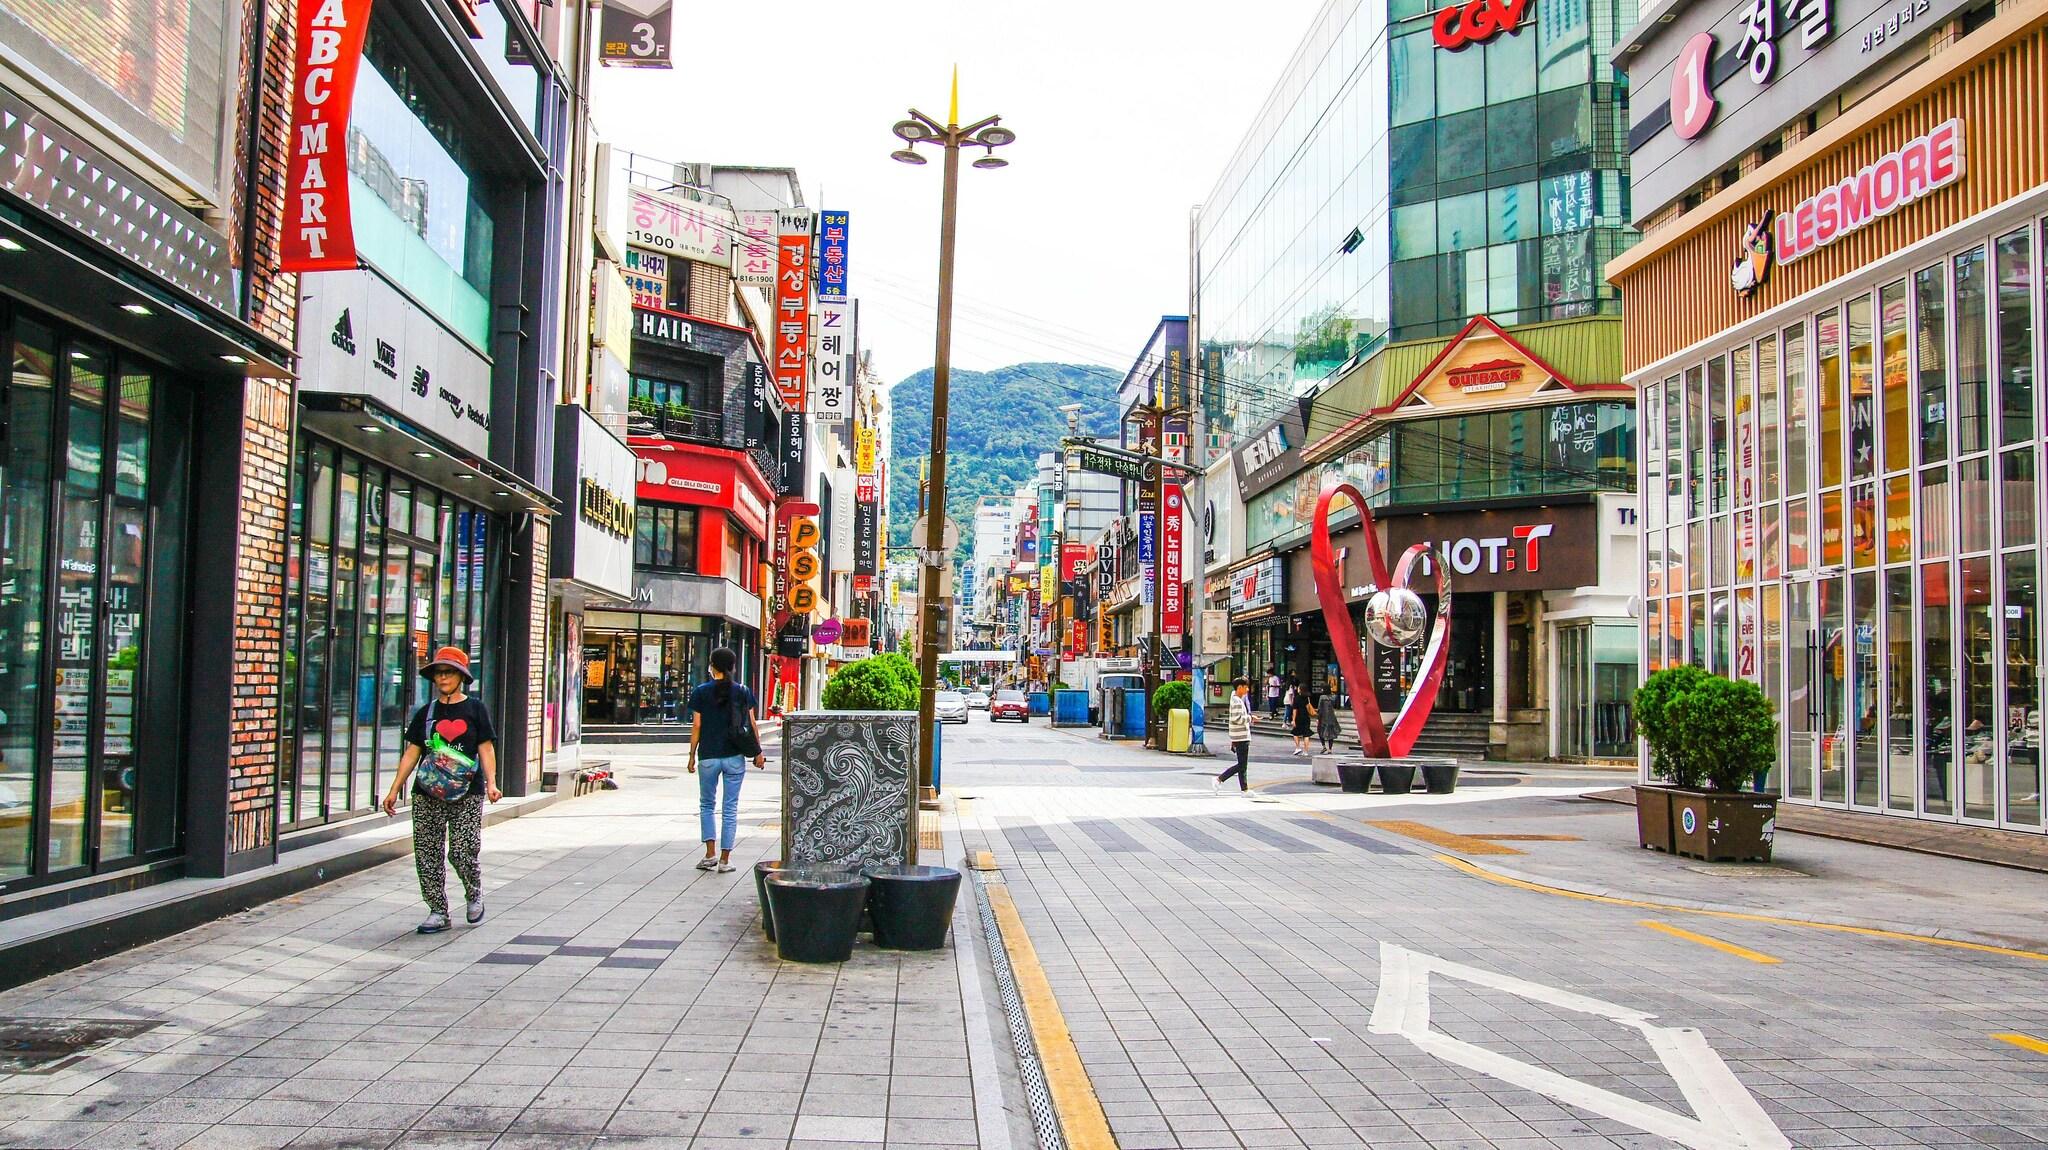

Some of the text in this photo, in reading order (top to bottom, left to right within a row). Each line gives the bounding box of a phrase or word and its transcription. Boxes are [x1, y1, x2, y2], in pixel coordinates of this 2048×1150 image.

[1432, 0, 1528, 48] CGV
[606, 42, 629, 56] 본관
[1776, 126, 1956, 263] LESMORE
[825, 215, 847, 225] 경성
[743, 228, 772, 273] 부동산
[823, 227, 846, 284] 부동산
[642, 313, 693, 344] HAIR
[376, 337, 397, 369] VANS
[821, 335, 843, 407] 헤어짱
[1448, 367, 1523, 390] OUTBACK
[746, 438, 758, 447] 3F
[791, 414, 803, 463] 준오헤어
[1166, 515, 1180, 532] 秀
[775, 520, 788, 612] 노래연습장
[1101, 546, 1113, 586] DVD
[1166, 534, 1180, 613] 노래연습장
